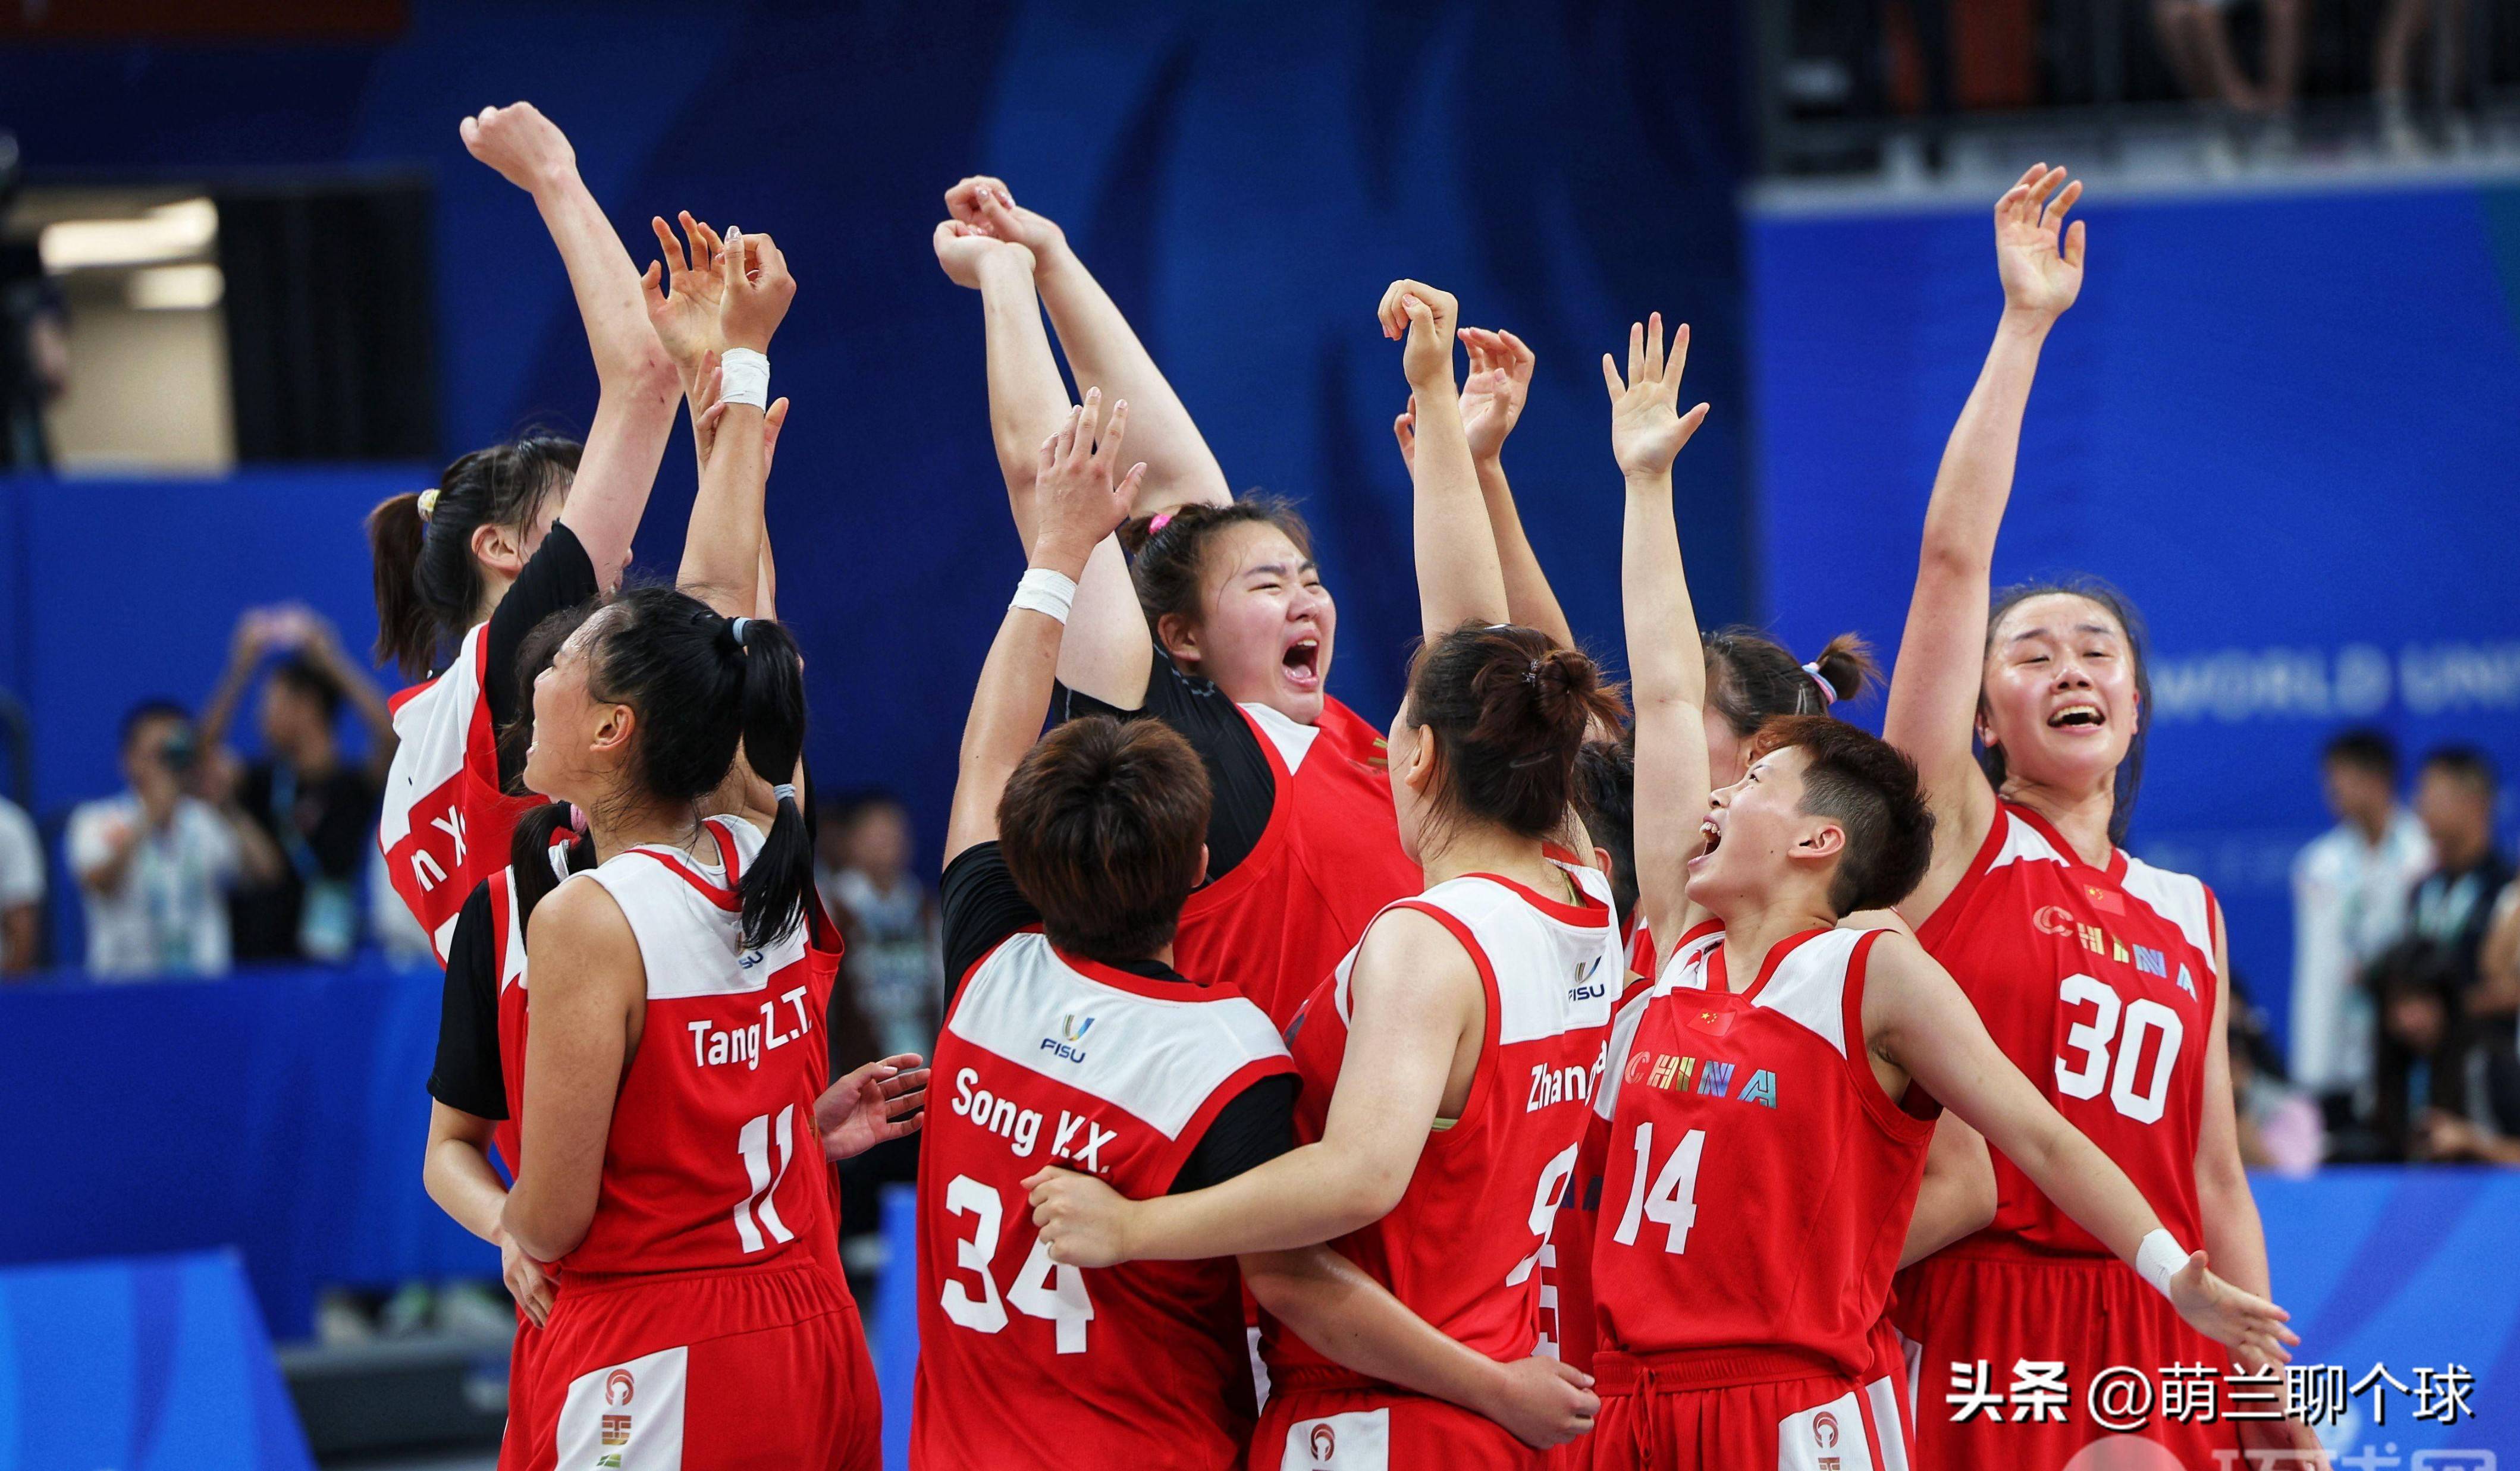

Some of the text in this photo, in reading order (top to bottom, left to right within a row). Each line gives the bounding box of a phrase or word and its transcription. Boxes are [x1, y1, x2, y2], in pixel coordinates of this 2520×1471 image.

[1567, 983, 1606, 1003] FISU
[2032, 905, 2198, 1003] CHINA
[688, 1019, 761, 1071] Tang
[1040, 1038, 1087, 1064] FISU
[1624, 1050, 1778, 1109] CHINA
[2055, 973, 2184, 1125] 30
[951, 1067, 1044, 1158] Song
[734, 1103, 795, 1255] 11
[1505, 1141, 1578, 1288] 9
[1612, 1121, 1706, 1256] 14
[940, 1174, 1095, 1355] 34
